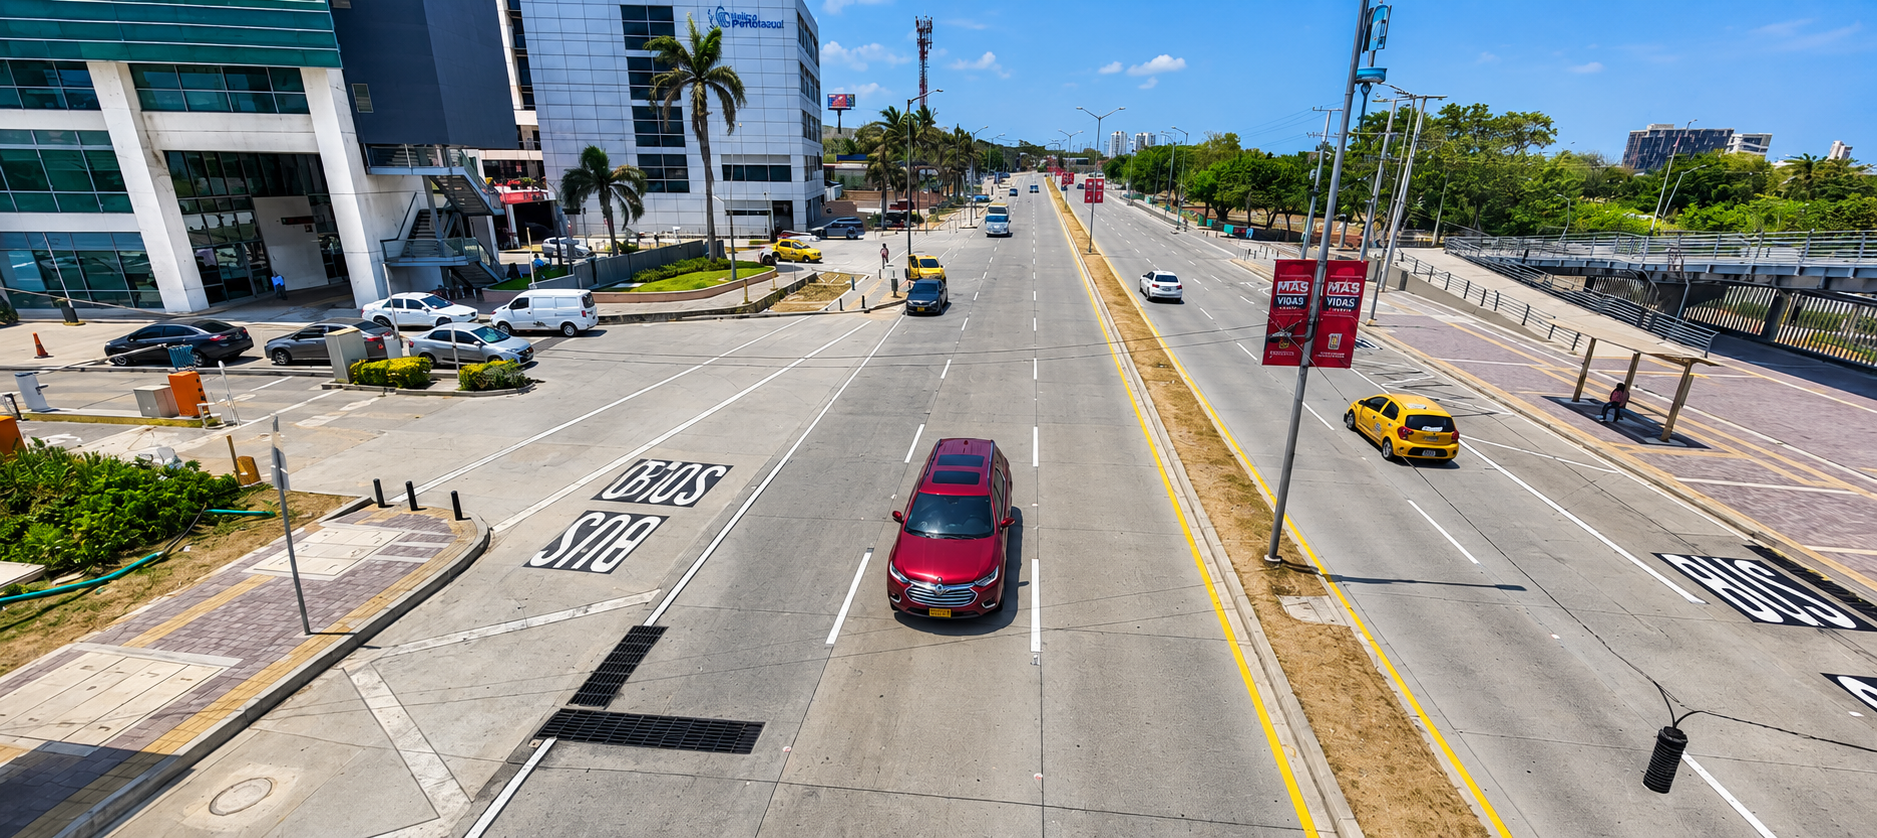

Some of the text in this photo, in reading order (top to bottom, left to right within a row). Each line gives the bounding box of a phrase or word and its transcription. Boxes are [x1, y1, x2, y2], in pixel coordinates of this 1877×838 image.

[1326, 296, 1355, 307] VIDAS
[530, 511, 662, 573] BUS
[1661, 553, 1857, 629] BUS
